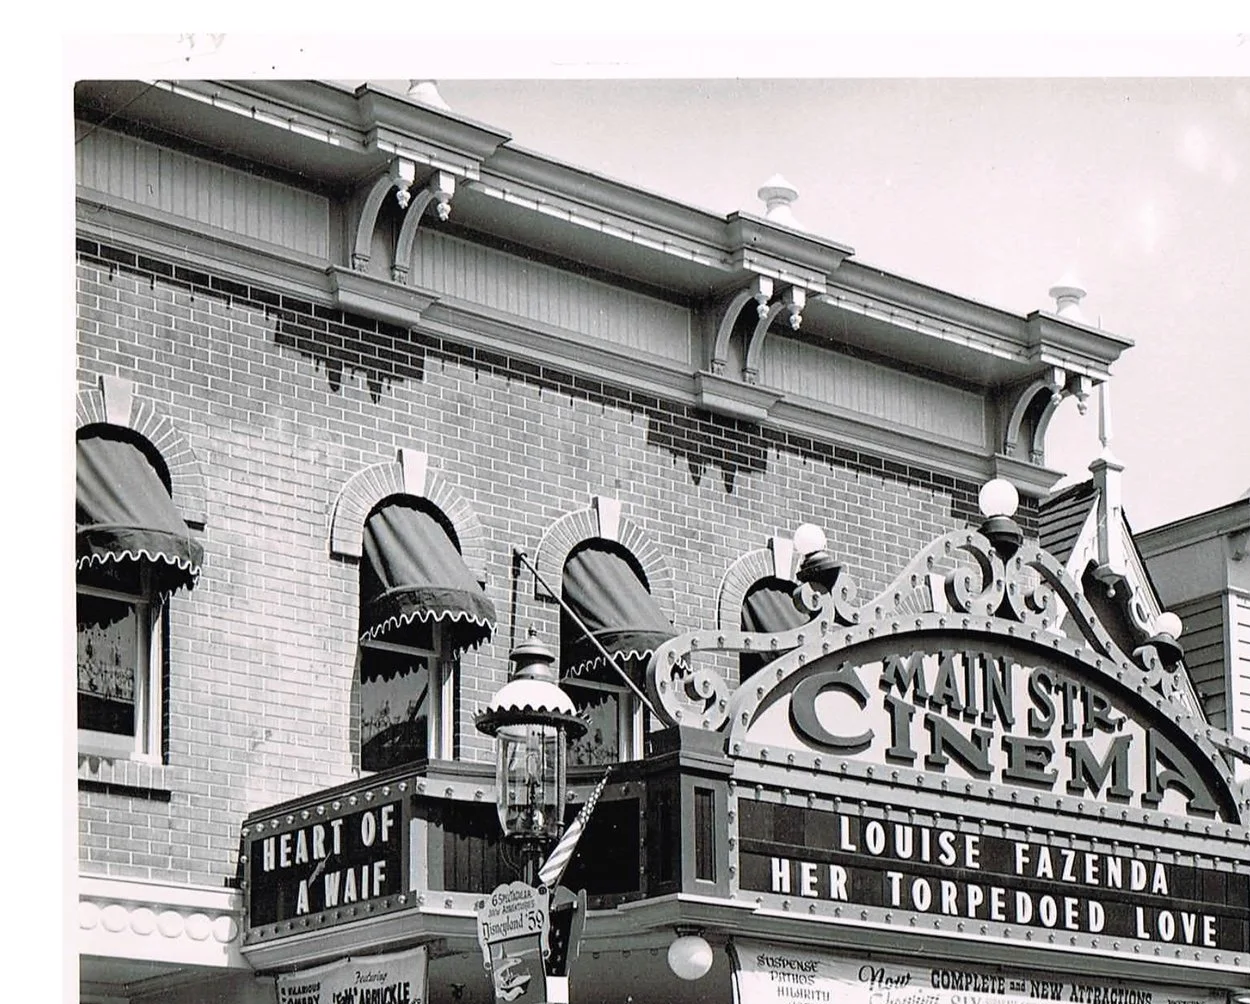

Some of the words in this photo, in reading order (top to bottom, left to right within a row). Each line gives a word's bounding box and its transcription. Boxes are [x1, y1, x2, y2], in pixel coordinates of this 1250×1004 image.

[880, 651, 1016, 732] MAIN
[788, 660, 1222, 822] CINEMA
[263, 818, 344, 872] HEART
[361, 804, 394, 847] OF
[840, 815, 981, 869] LOUISE
[1015, 842, 1169, 896] FAZENDA
[296, 879, 310, 915] A
[325, 860, 386, 908] WAIF
[492, 893, 498, 907] 6
[771, 857, 849, 902] HER
[886, 870, 1105, 933] TORPEDOED
[1136, 905, 1218, 947] LOVE
[482, 912, 524, 942] Disneyland
[756, 952, 820, 974] SUSPENSE
[771, 970, 816, 986] PATHOS
[858, 964, 912, 991] Now
[930, 968, 1006, 995] COMPLETE
[1009, 980, 1026, 993] and
[1030, 979, 1064, 1000] NEW
